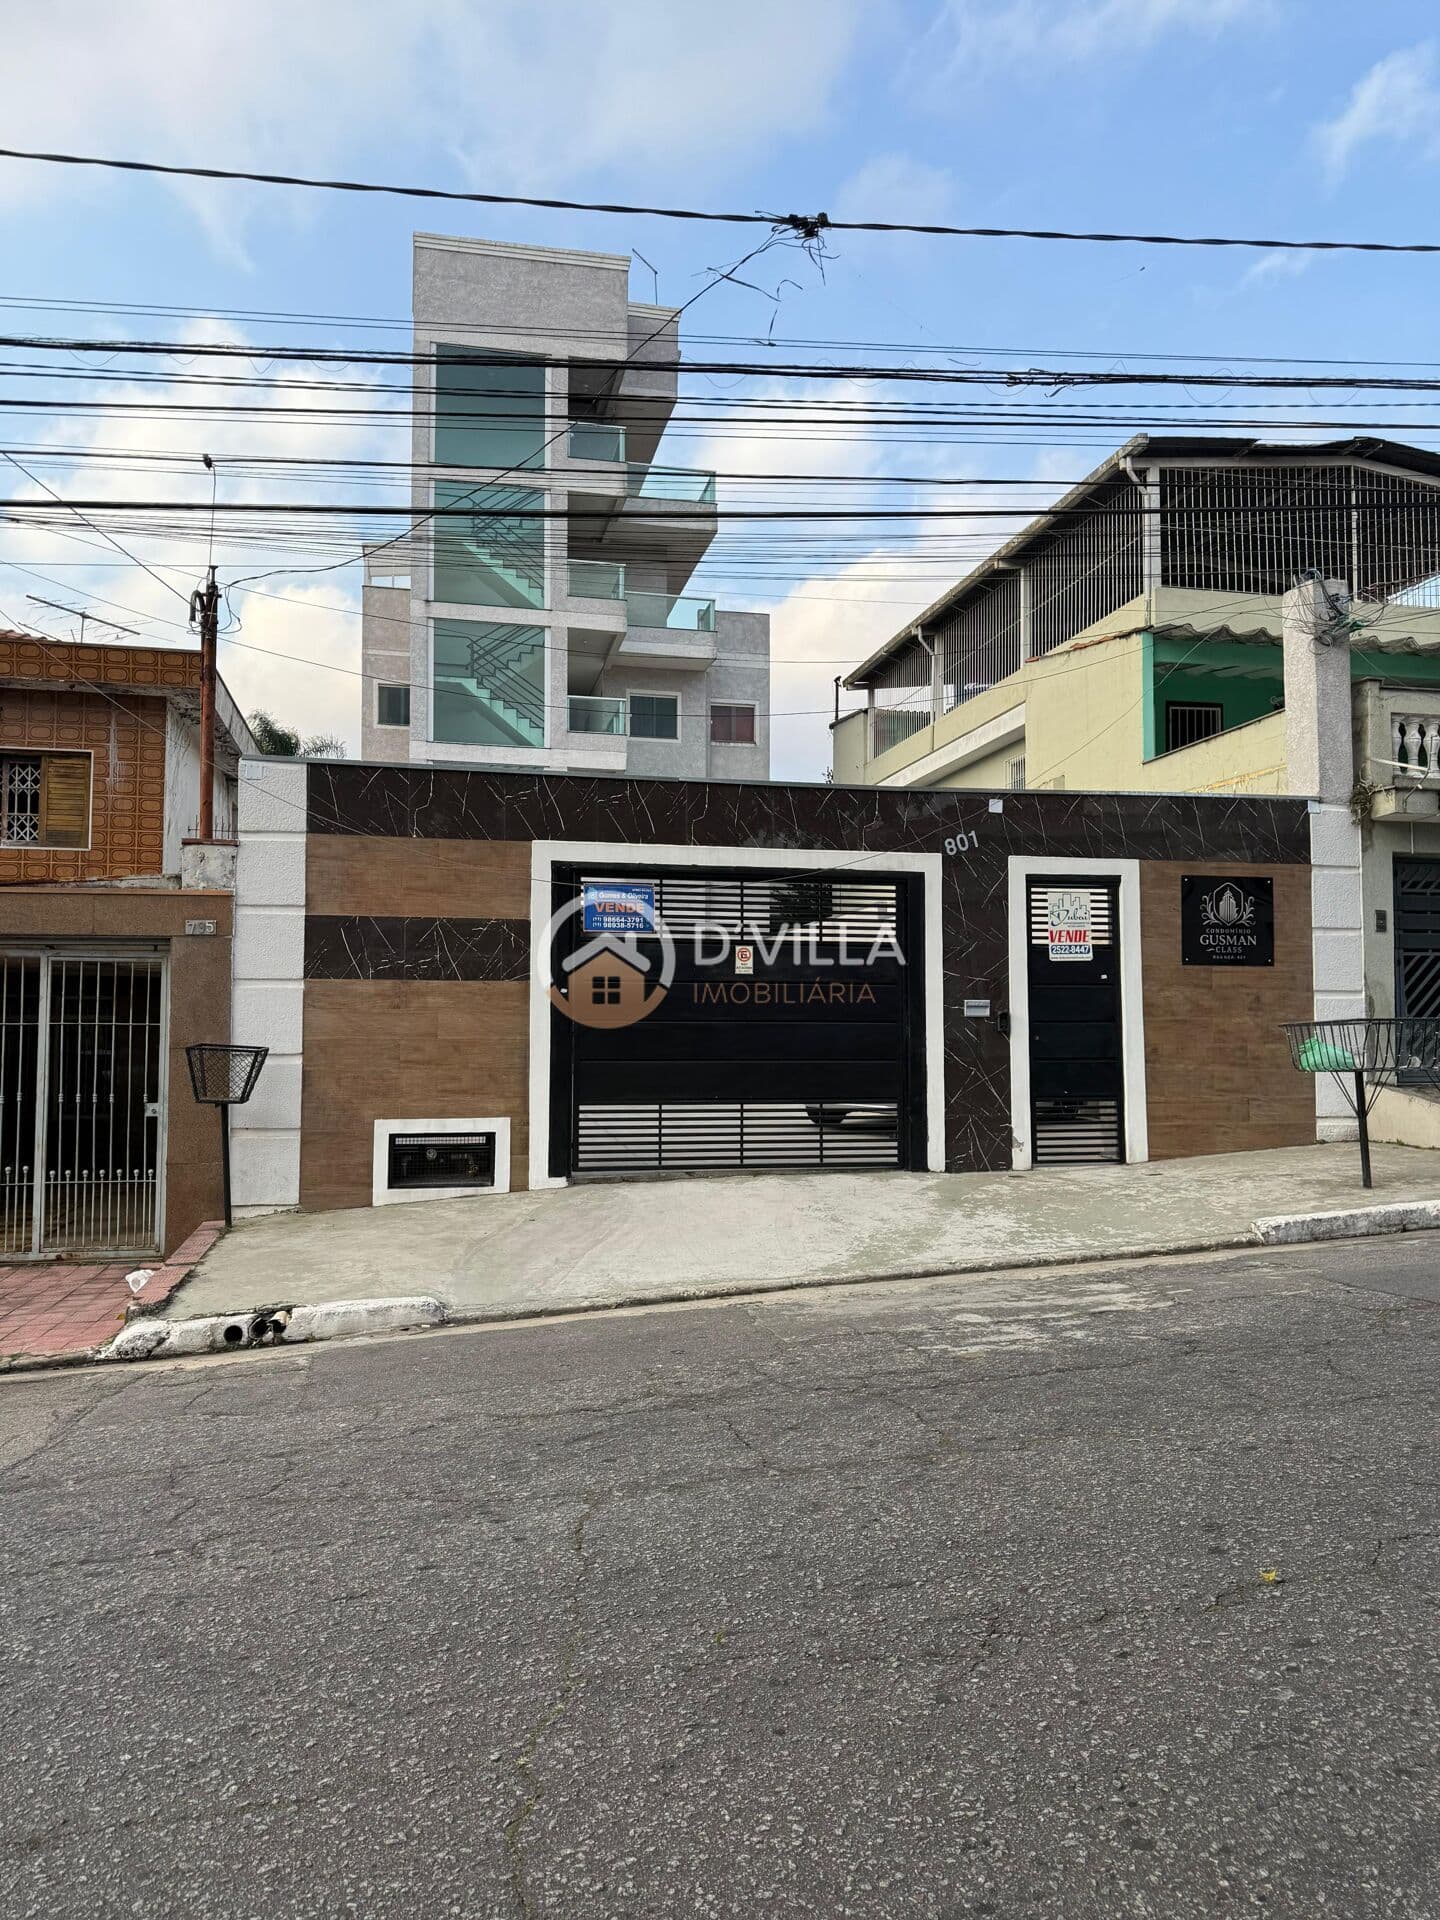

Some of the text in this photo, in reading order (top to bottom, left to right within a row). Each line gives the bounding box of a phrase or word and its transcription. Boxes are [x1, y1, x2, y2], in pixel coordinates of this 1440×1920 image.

[944, 830, 979, 856] 801
[594, 901, 645, 913] VENDE
[1049, 929, 1089, 943] VENDE
[1199, 934, 1257, 946] GUSMAN
